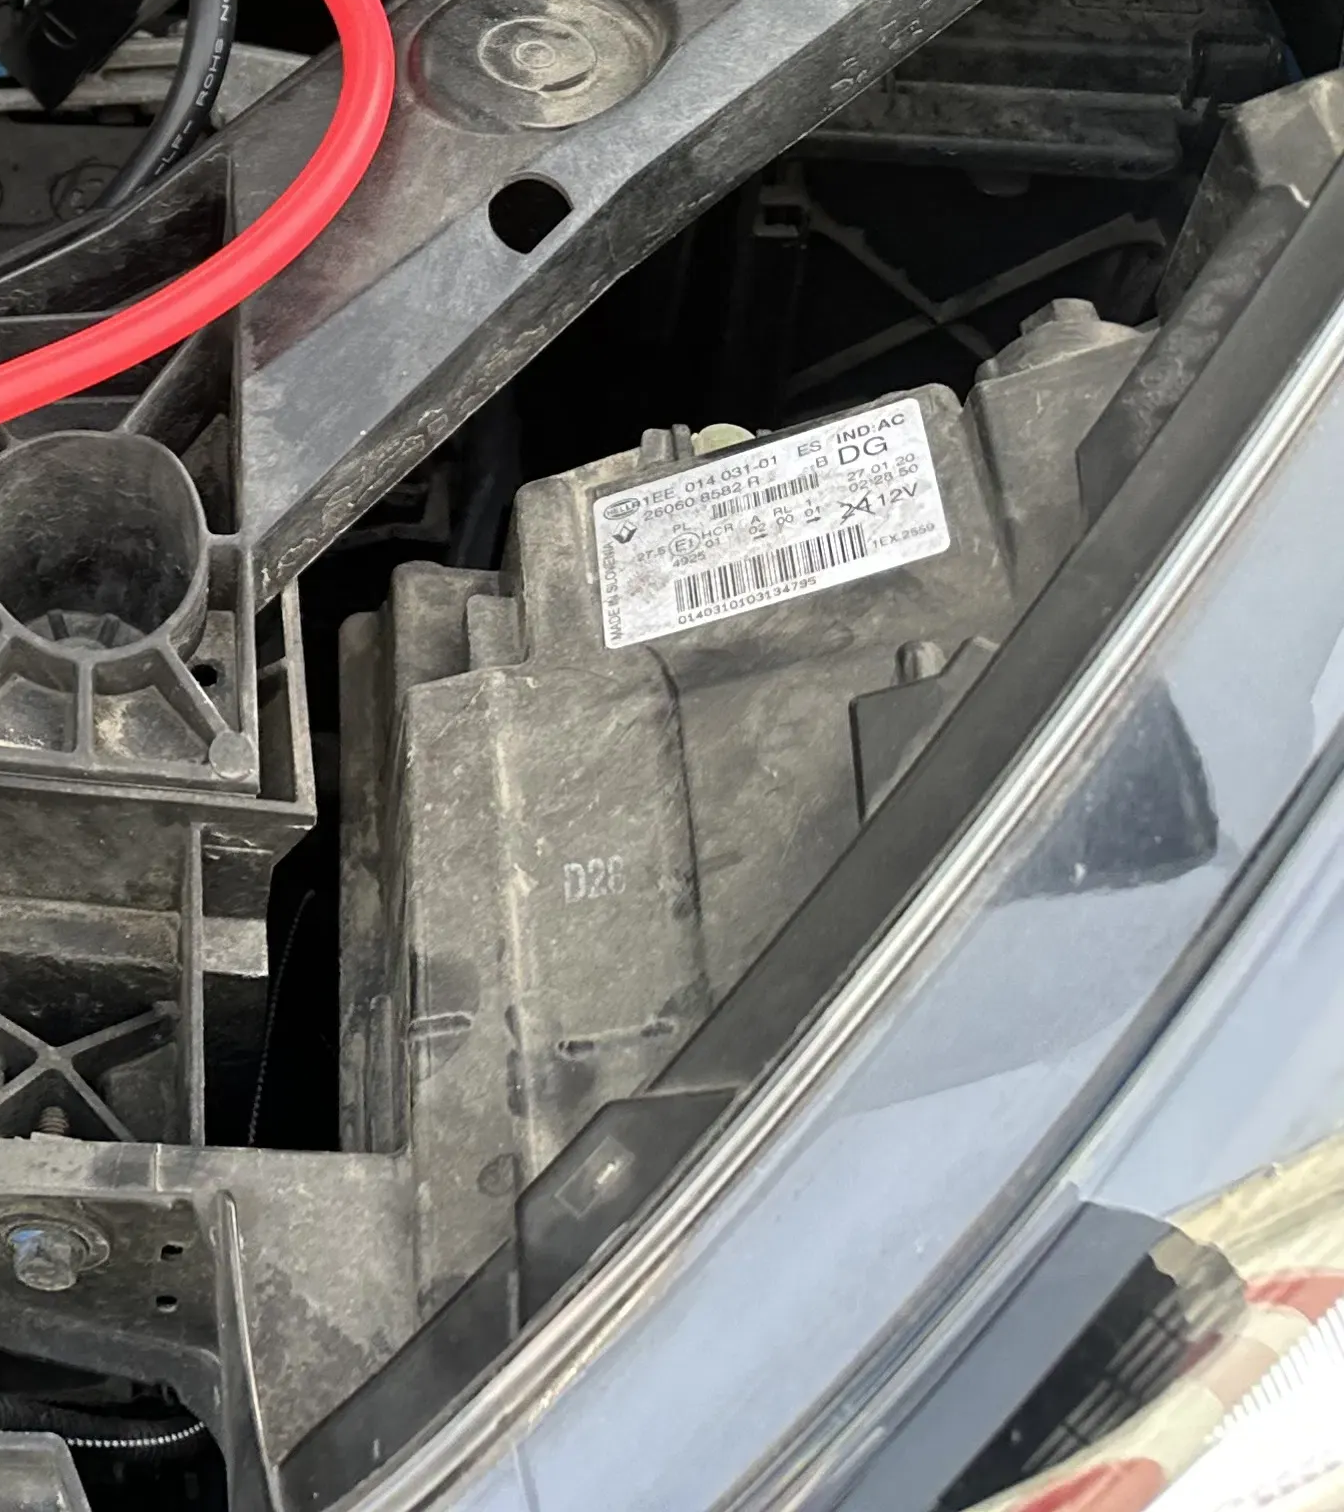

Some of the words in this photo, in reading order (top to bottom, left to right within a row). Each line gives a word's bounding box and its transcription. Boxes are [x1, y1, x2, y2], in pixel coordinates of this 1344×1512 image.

[643, 498, 695, 521] 26060
[700, 481, 742, 504] 8582
[838, 436, 888, 465] DG
[685, 475, 716, 493] 014
[721, 455, 778, 482] 031-01
[797, 440, 822, 458] ES
[702, 523, 734, 538] HCR
[878, 482, 918, 507] 12V
[608, 607, 624, 640] MADE
